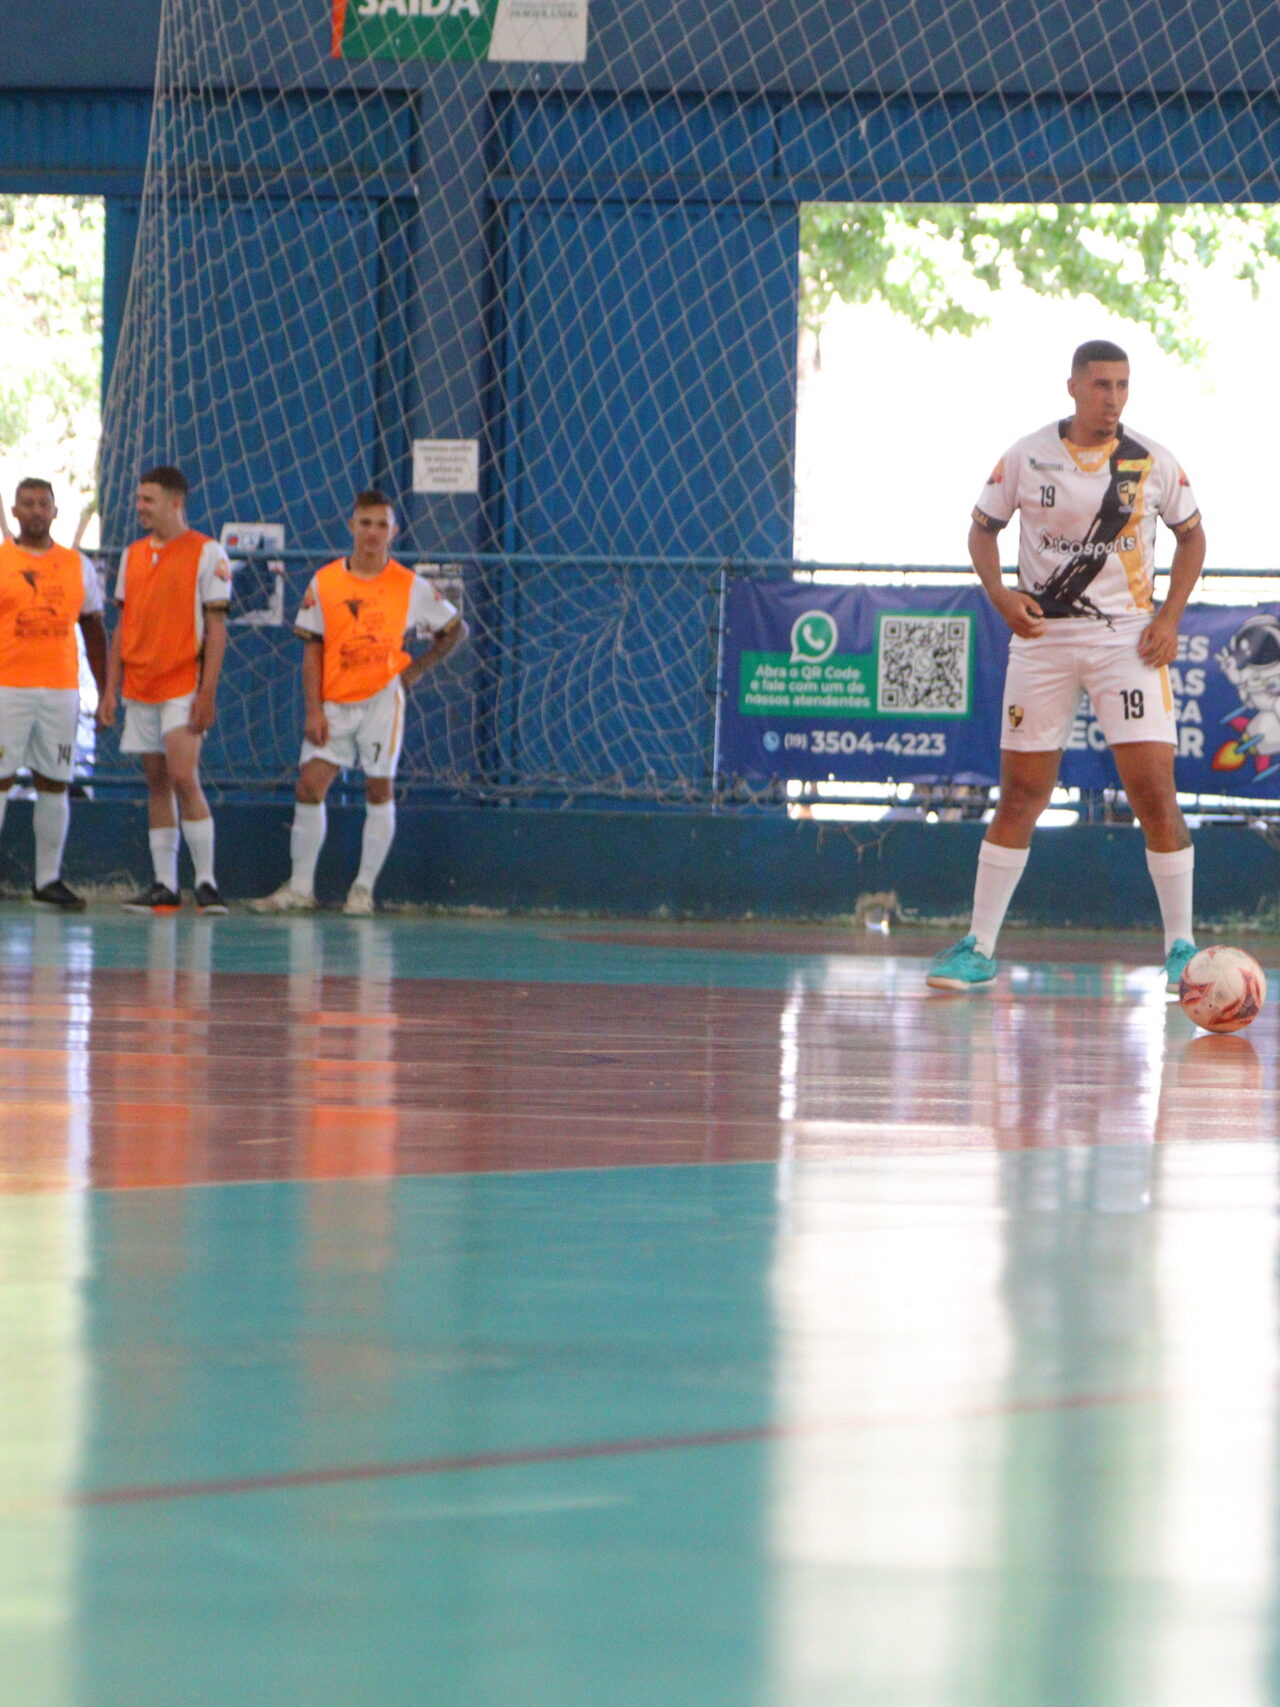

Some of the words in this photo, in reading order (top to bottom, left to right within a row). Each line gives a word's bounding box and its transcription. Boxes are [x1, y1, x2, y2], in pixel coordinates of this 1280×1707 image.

[1040, 485, 1056, 508] 19
[755, 665, 786, 678] Abra
[789, 669, 797, 679] o
[801, 666, 821, 680] QR
[825, 666, 861, 680] Code
[750, 681, 758, 691] e
[762, 679, 786, 692] fale
[789, 682, 819, 692] com
[821, 682, 844, 693] um
[847, 680, 866, 693] de
[745, 695, 790, 706] nossos
[793, 694, 871, 708] atendentes
[1120, 689, 1144, 720] 19
[372, 741, 382, 763] 7
[784, 733, 808, 751] (19)
[811, 730, 946, 757] 3504-4223
